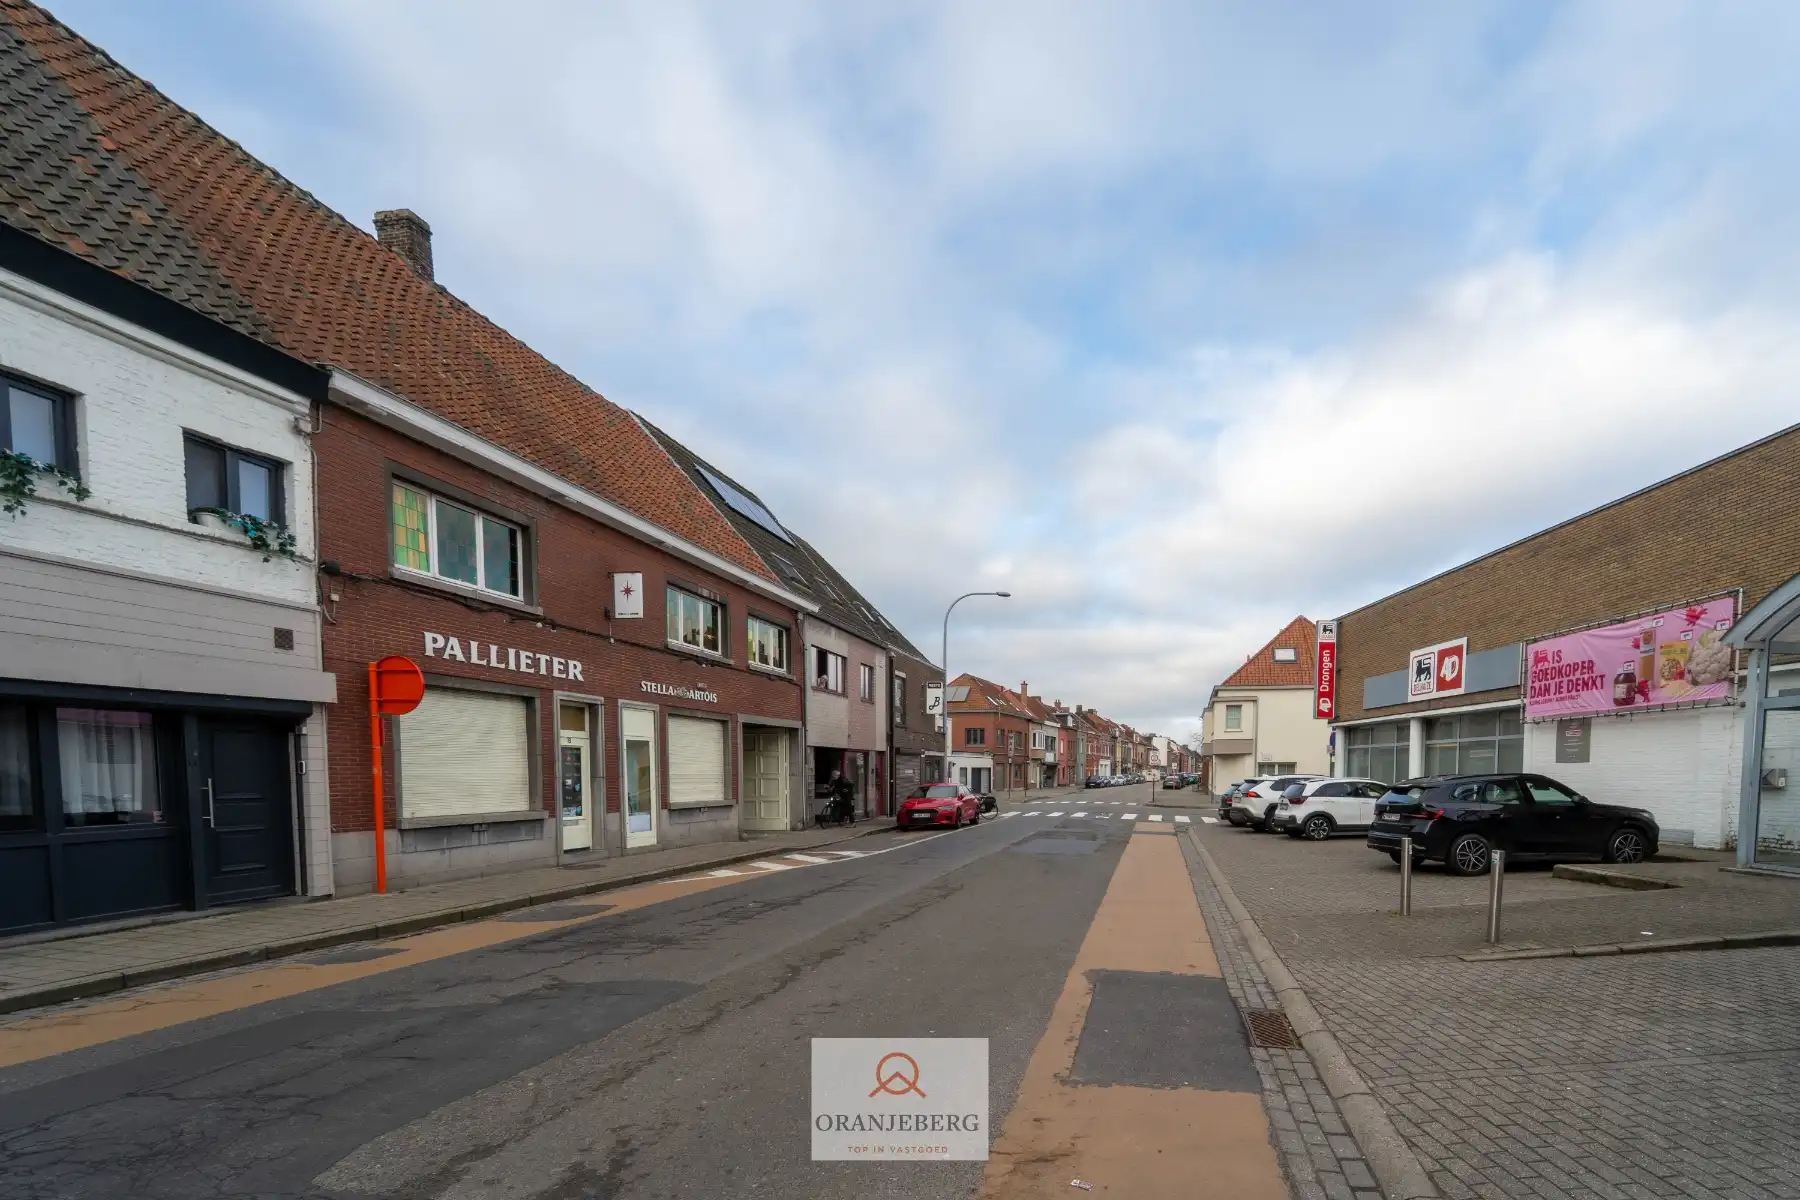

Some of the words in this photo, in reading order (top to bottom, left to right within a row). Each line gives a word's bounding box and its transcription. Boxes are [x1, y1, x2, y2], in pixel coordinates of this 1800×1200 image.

[423, 631, 585, 682] PALLIETER
[1552, 649, 1563, 664] IS
[1320, 650, 1333, 692] Drongen
[1531, 659, 1595, 685] GOEDKOPER
[641, 680, 675, 696] STELLA
[688, 689, 718, 703] ARTOIS
[1530, 682, 1551, 699] DAN
[1553, 680, 1564, 696] JE
